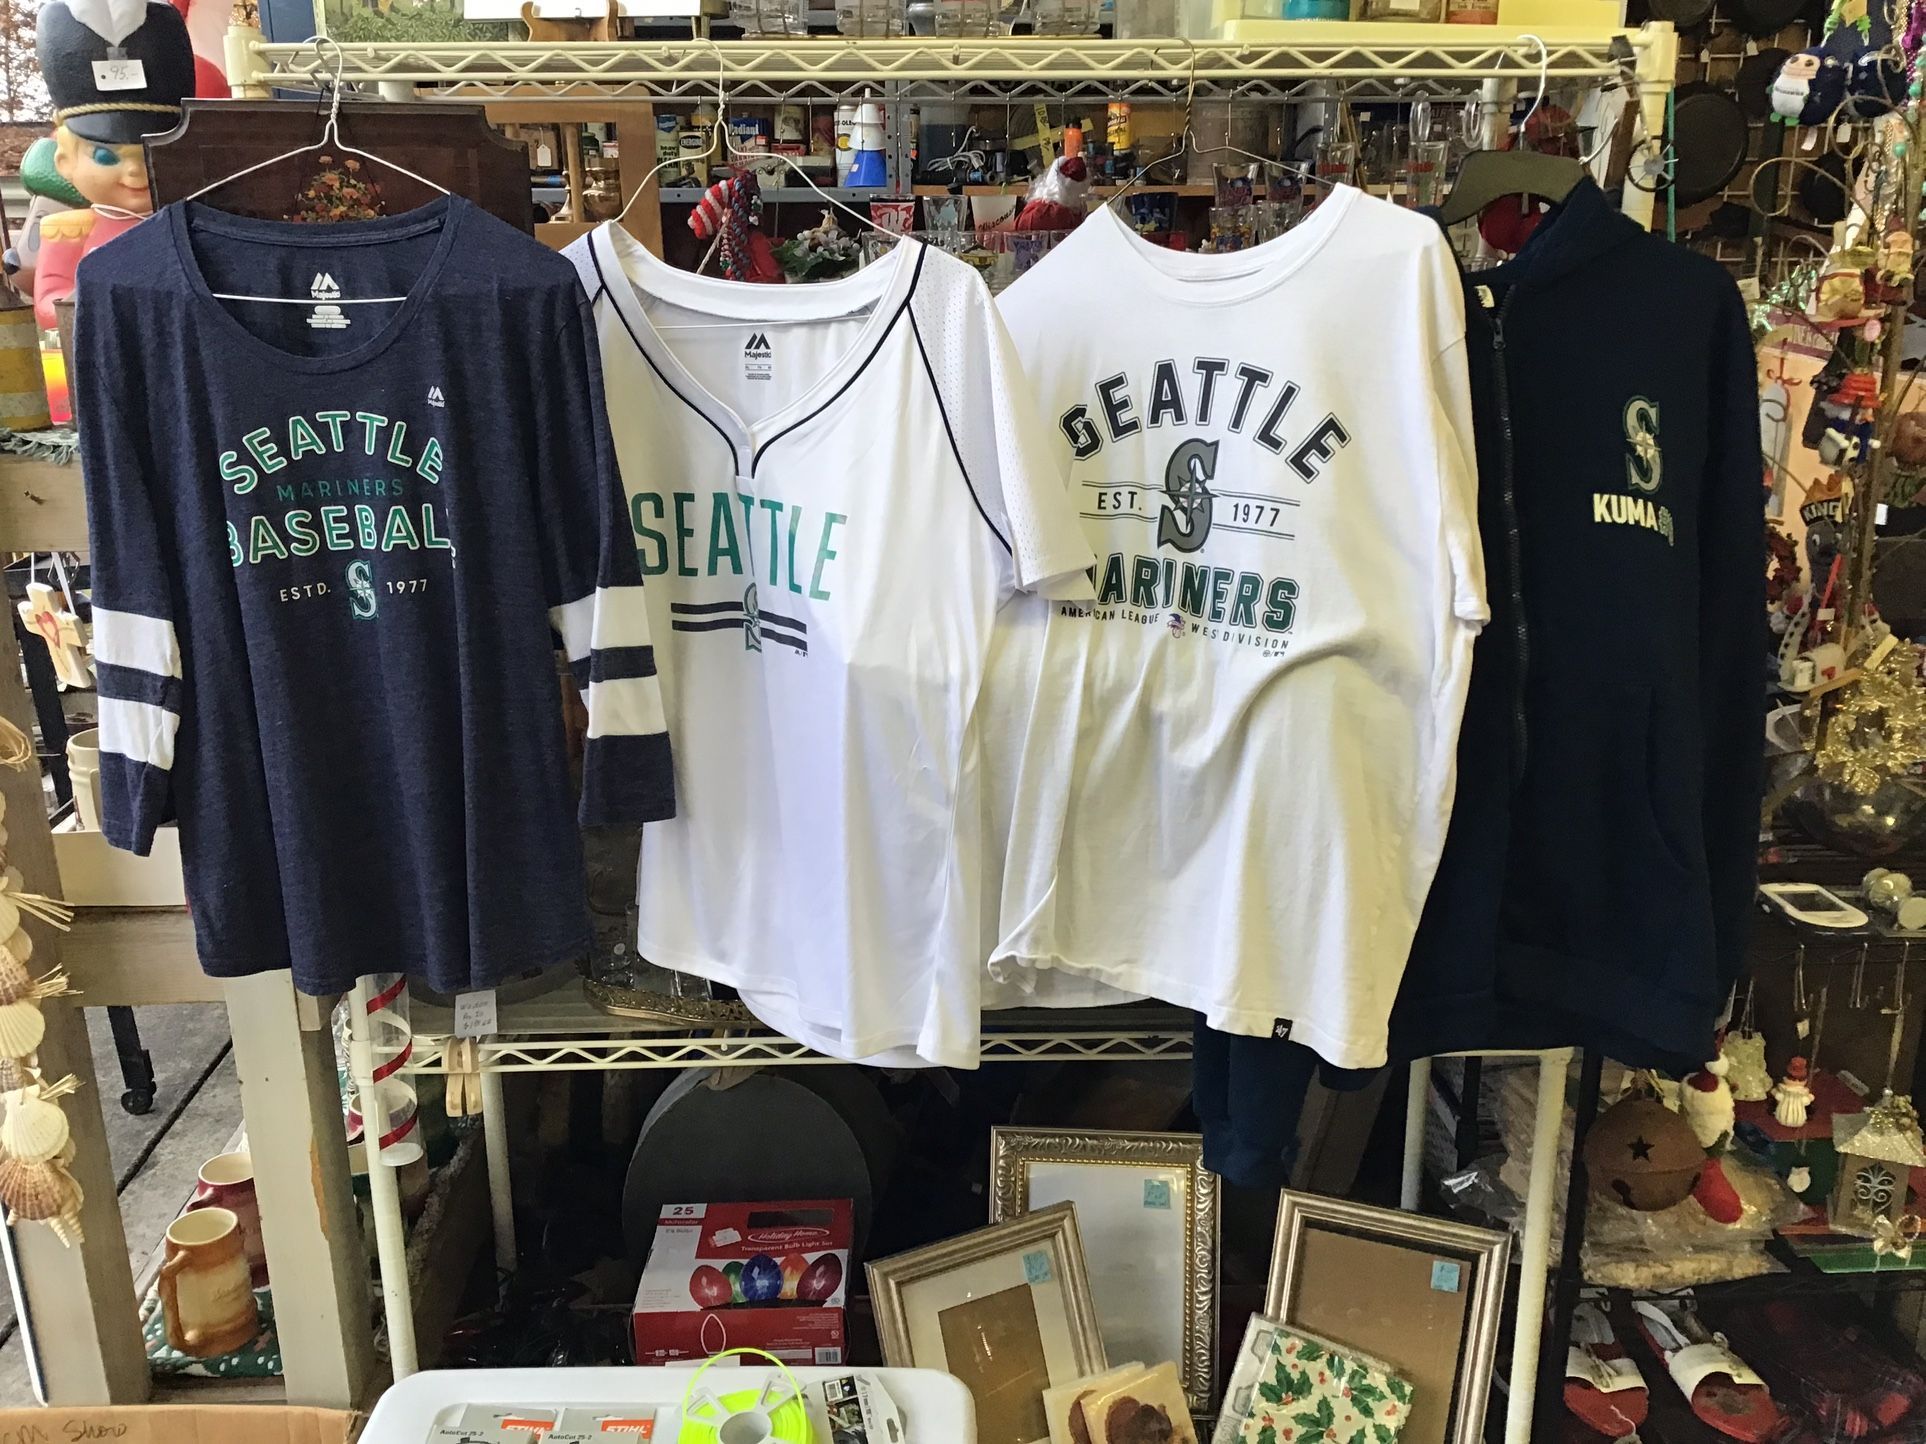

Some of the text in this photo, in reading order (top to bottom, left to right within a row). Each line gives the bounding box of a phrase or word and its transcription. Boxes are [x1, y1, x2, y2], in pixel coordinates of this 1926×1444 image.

[744, 351, 772, 360] Majestic
[1059, 356, 1352, 484] SEATTLE
[219, 411, 443, 495] SEATTLE
[276, 478, 404, 501] MARINERS
[1097, 491, 1281, 527] EST. 1977
[1593, 493, 1659, 531] KUMA
[631, 491, 848, 601] SEATTLE
[279, 579, 428, 602] ESTD. 1977
[1085, 552, 1300, 634] ARINERS
[1121, 608, 1160, 625] LEAGUE
[1222, 631, 1289, 650] DIVISION
[672, 1206, 694, 1216] 25
[784, 1242, 801, 1250] Bulb
[801, 1240, 820, 1248] Light
[548, 1433, 576, 1441] AutoCut
[606, 1425, 648, 1434] STIHL
